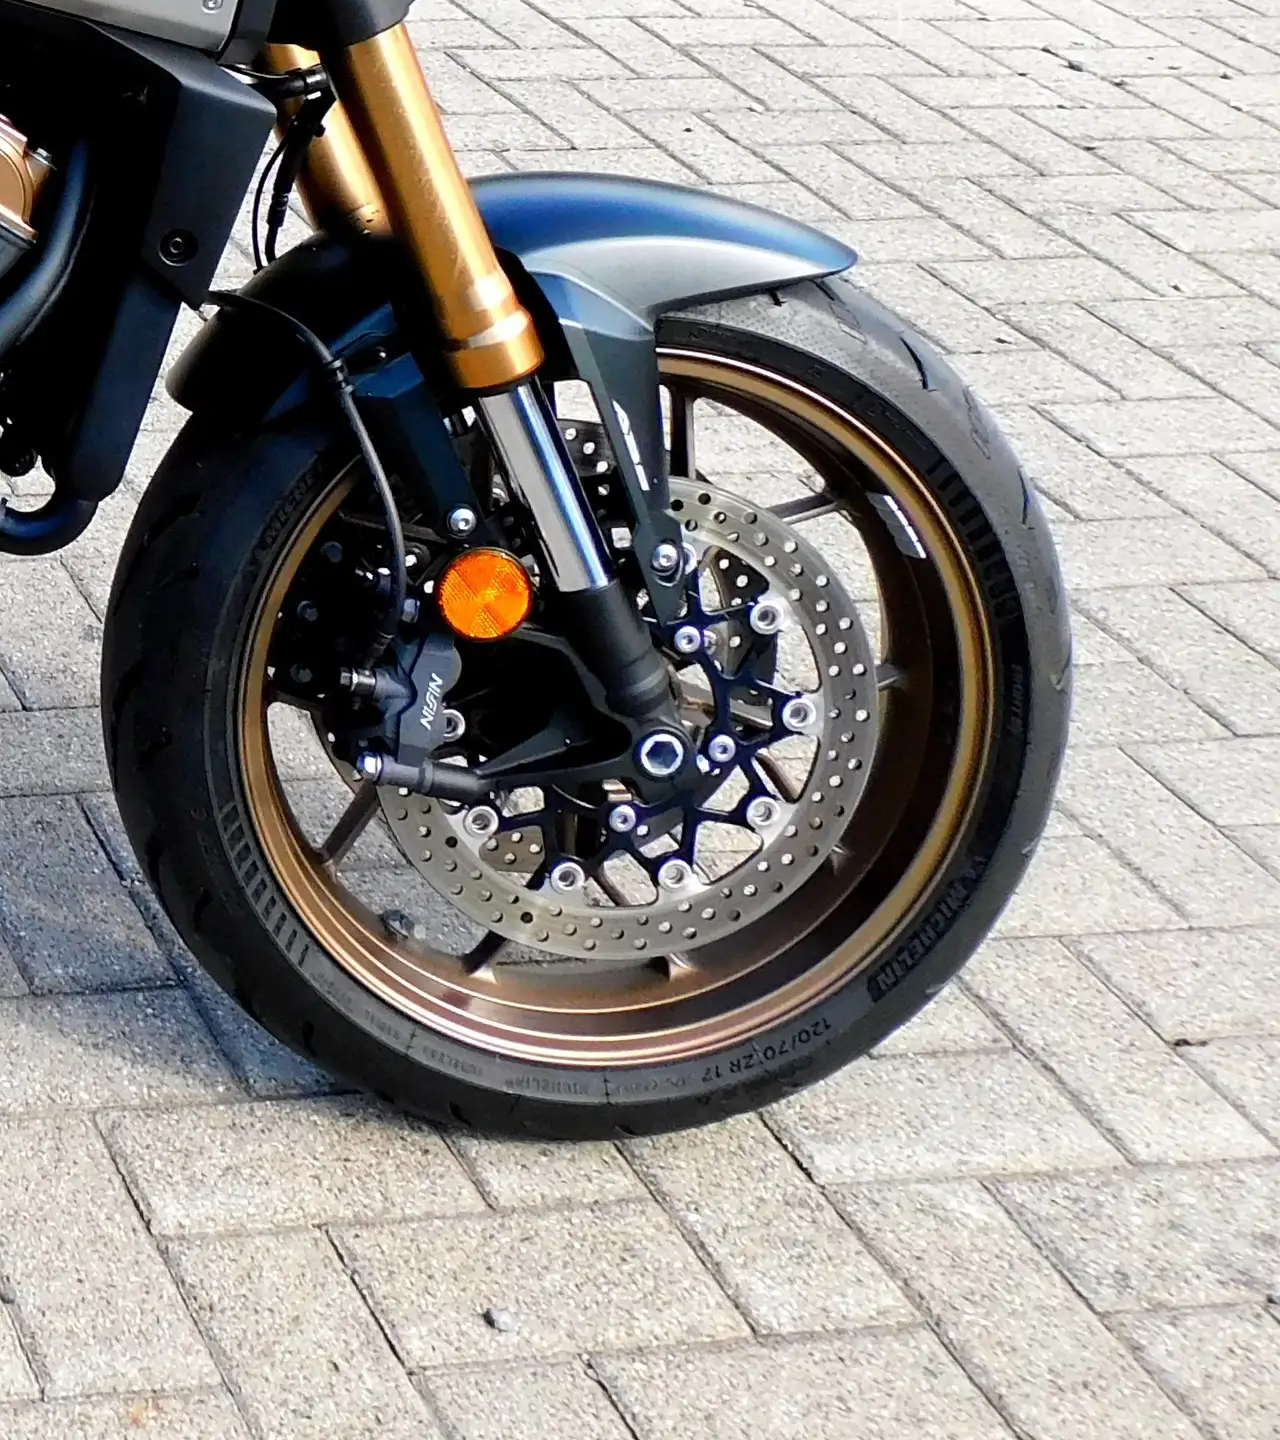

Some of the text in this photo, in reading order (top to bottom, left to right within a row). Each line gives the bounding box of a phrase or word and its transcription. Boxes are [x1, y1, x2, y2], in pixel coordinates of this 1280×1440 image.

[419, 672, 444, 731] NISSIN
[876, 878, 970, 991] MICHELIN
[762, 1016, 832, 1055] 120/70
[702, 1068, 722, 1083] 17
[730, 1059, 755, 1075] ZR
